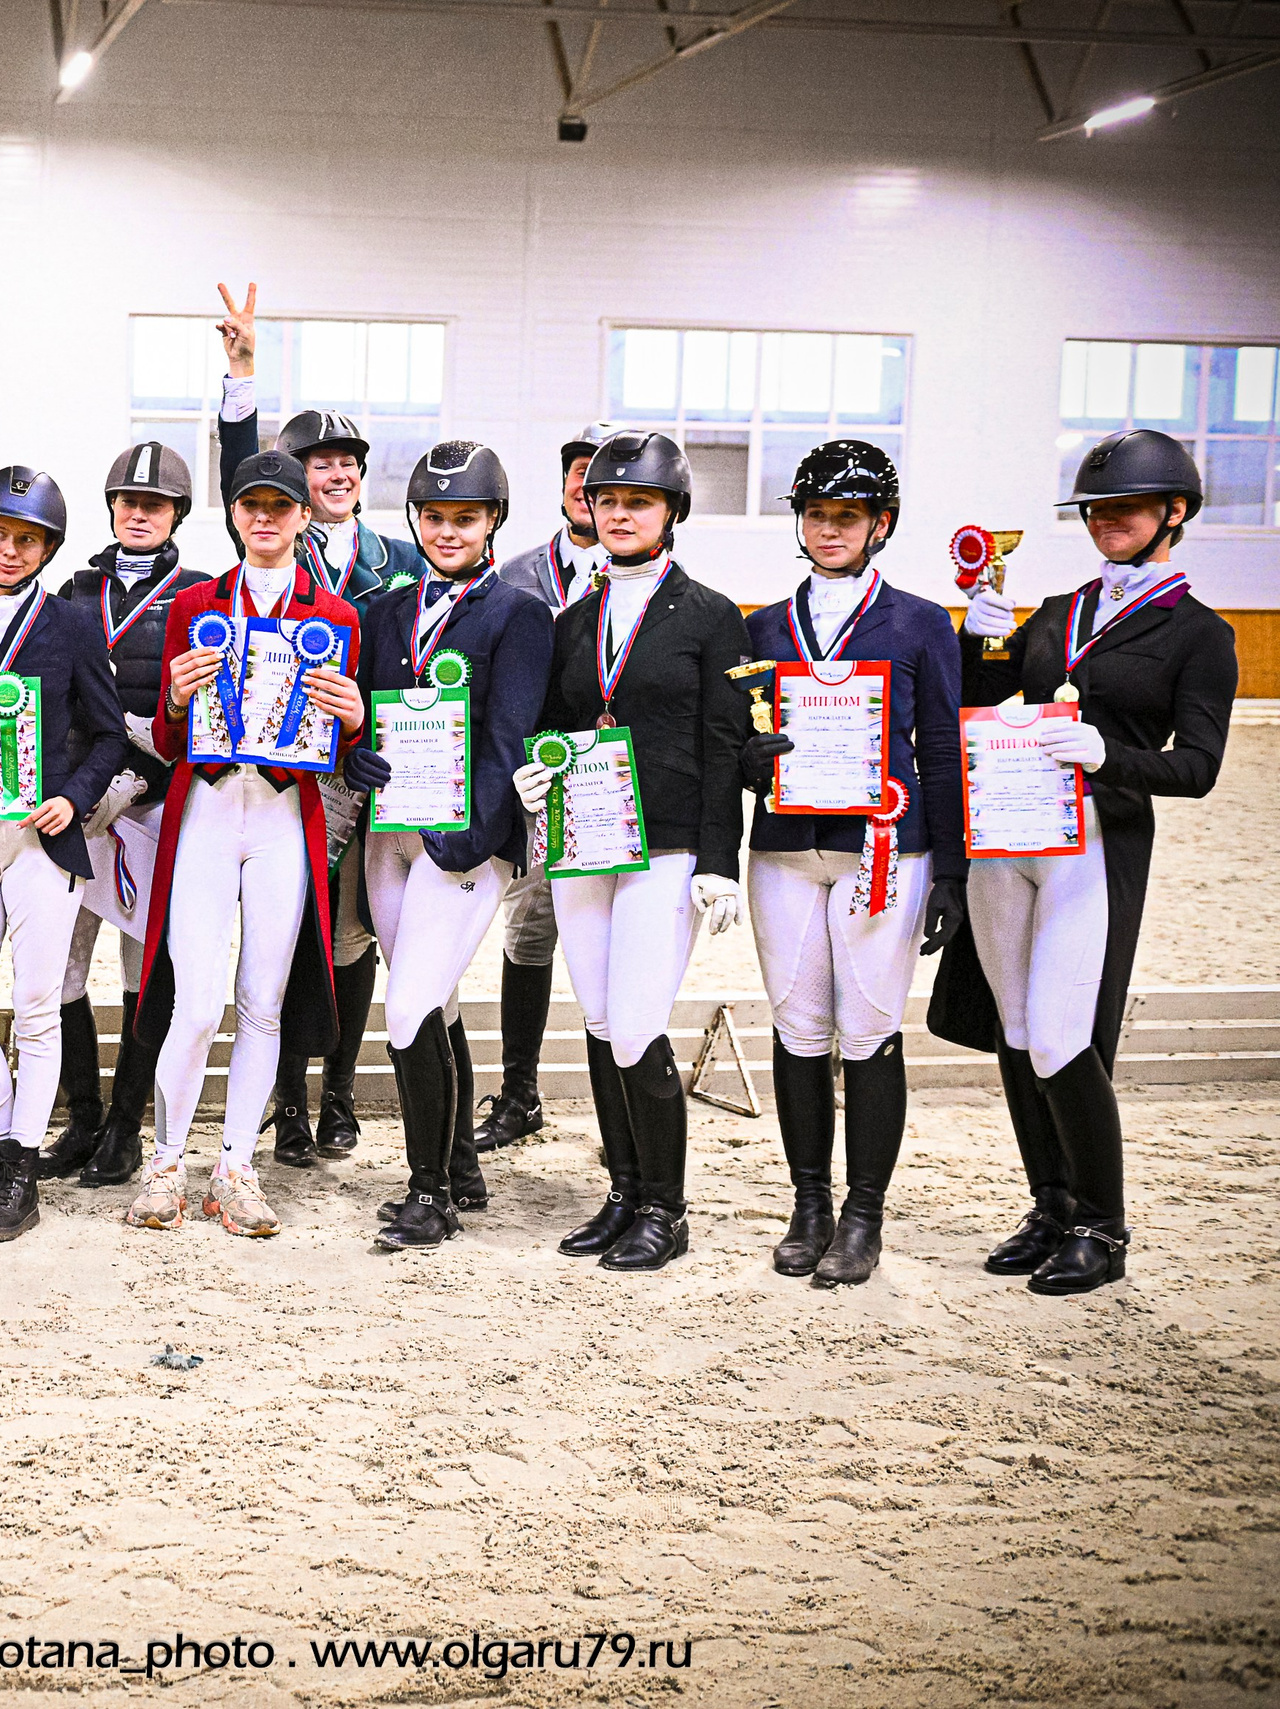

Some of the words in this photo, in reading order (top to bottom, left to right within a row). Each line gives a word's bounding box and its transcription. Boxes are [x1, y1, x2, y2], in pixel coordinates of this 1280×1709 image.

[263, 651, 293, 664] ДИП
[798, 695, 861, 708] ДИПЛОМ
[391, 720, 446, 733] ДИПЛОМ
[986, 738, 1038, 751] ДИПЛО
[569, 761, 610, 775] ПЛОМ
